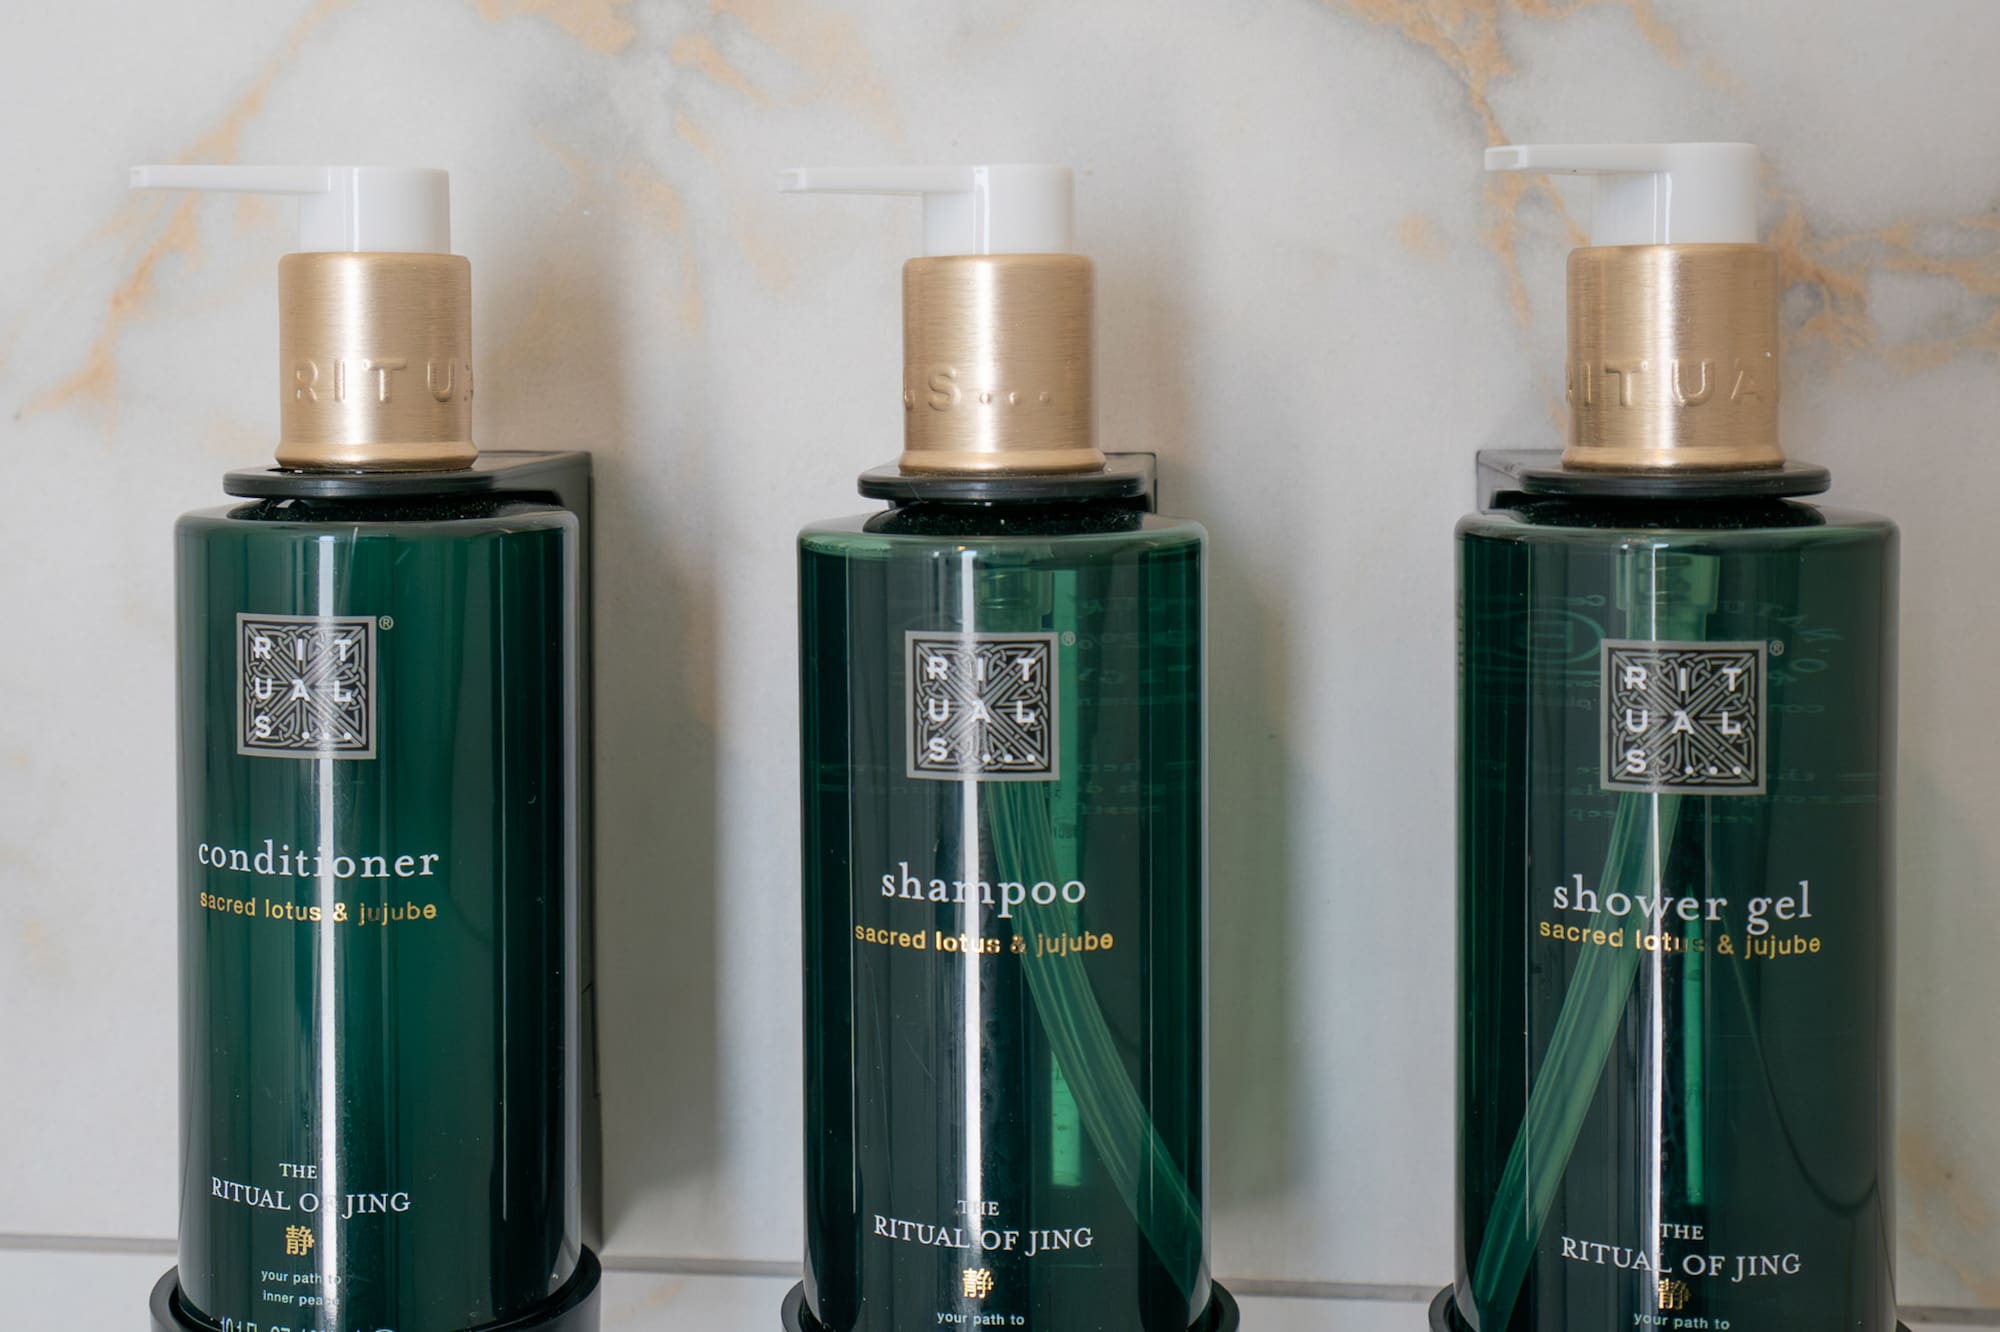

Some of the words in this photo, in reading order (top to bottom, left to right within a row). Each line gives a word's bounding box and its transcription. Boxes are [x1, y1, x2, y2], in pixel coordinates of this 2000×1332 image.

[198, 838, 440, 878] conditioner
[881, 861, 1086, 918] shampoo
[1553, 873, 1728, 921] shower
[1746, 880, 1812, 936] gel
[200, 891, 256, 917] sacred
[265, 899, 322, 922] lotus
[332, 902, 348, 922] &
[358, 901, 437, 927] jujube
[855, 924, 926, 950] sacred
[935, 931, 1001, 954] lotus
[1010, 934, 1027, 954] &
[1036, 931, 1114, 957] jujube
[1539, 920, 1623, 948] sacred
[1635, 929, 1705, 952] lotus
[1717, 934, 1734, 955] &
[1744, 933, 1821, 960] jujube
[279, 1163, 318, 1179] THE
[211, 1176, 291, 1211] RITUAL
[341, 1192, 411, 1219] JING
[873, 1214, 970, 1249] RITUAL
[980, 1230, 1020, 1251] OF
[1024, 1227, 1094, 1257] JING
[1659, 1223, 1704, 1240] THE
[261, 1269, 289, 1282] your
[293, 1273, 322, 1286] path
[1561, 1236, 1672, 1274] RITUAL
[1682, 1254, 1725, 1276] OF
[1731, 1253, 1801, 1283] JING
[263, 1290, 294, 1304] inner
[936, 1311, 967, 1325] your
[973, 1313, 1005, 1327] path
[1010, 1314, 1025, 1326] to
[1633, 1312, 1668, 1326] your
[1673, 1315, 1708, 1330] path
[1714, 1317, 1731, 1330] to
